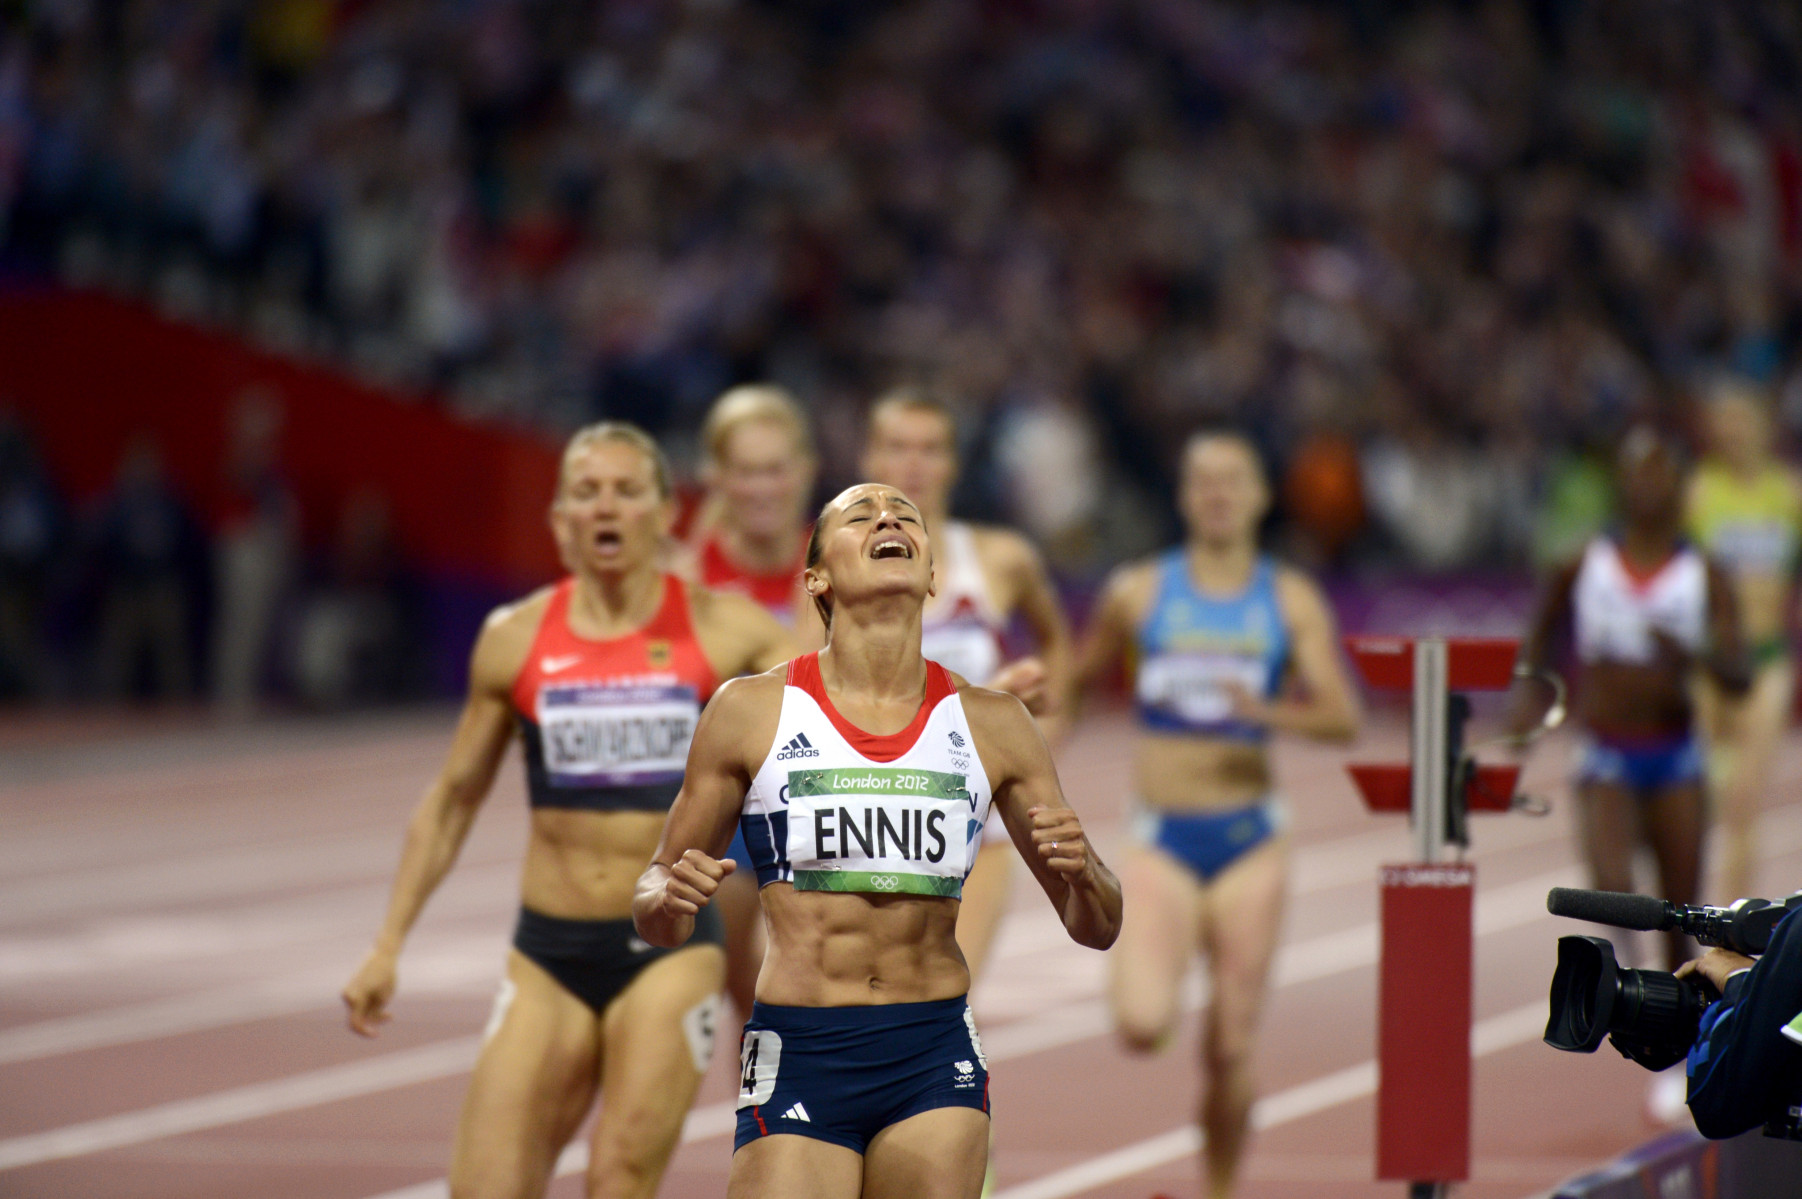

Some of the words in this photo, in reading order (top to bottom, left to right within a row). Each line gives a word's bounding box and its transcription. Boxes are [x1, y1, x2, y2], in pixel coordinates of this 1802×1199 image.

[777, 747, 820, 761] adidas
[832, 773, 892, 790] London
[895, 775, 930, 792] 2012
[814, 806, 947, 864] ENNIS
